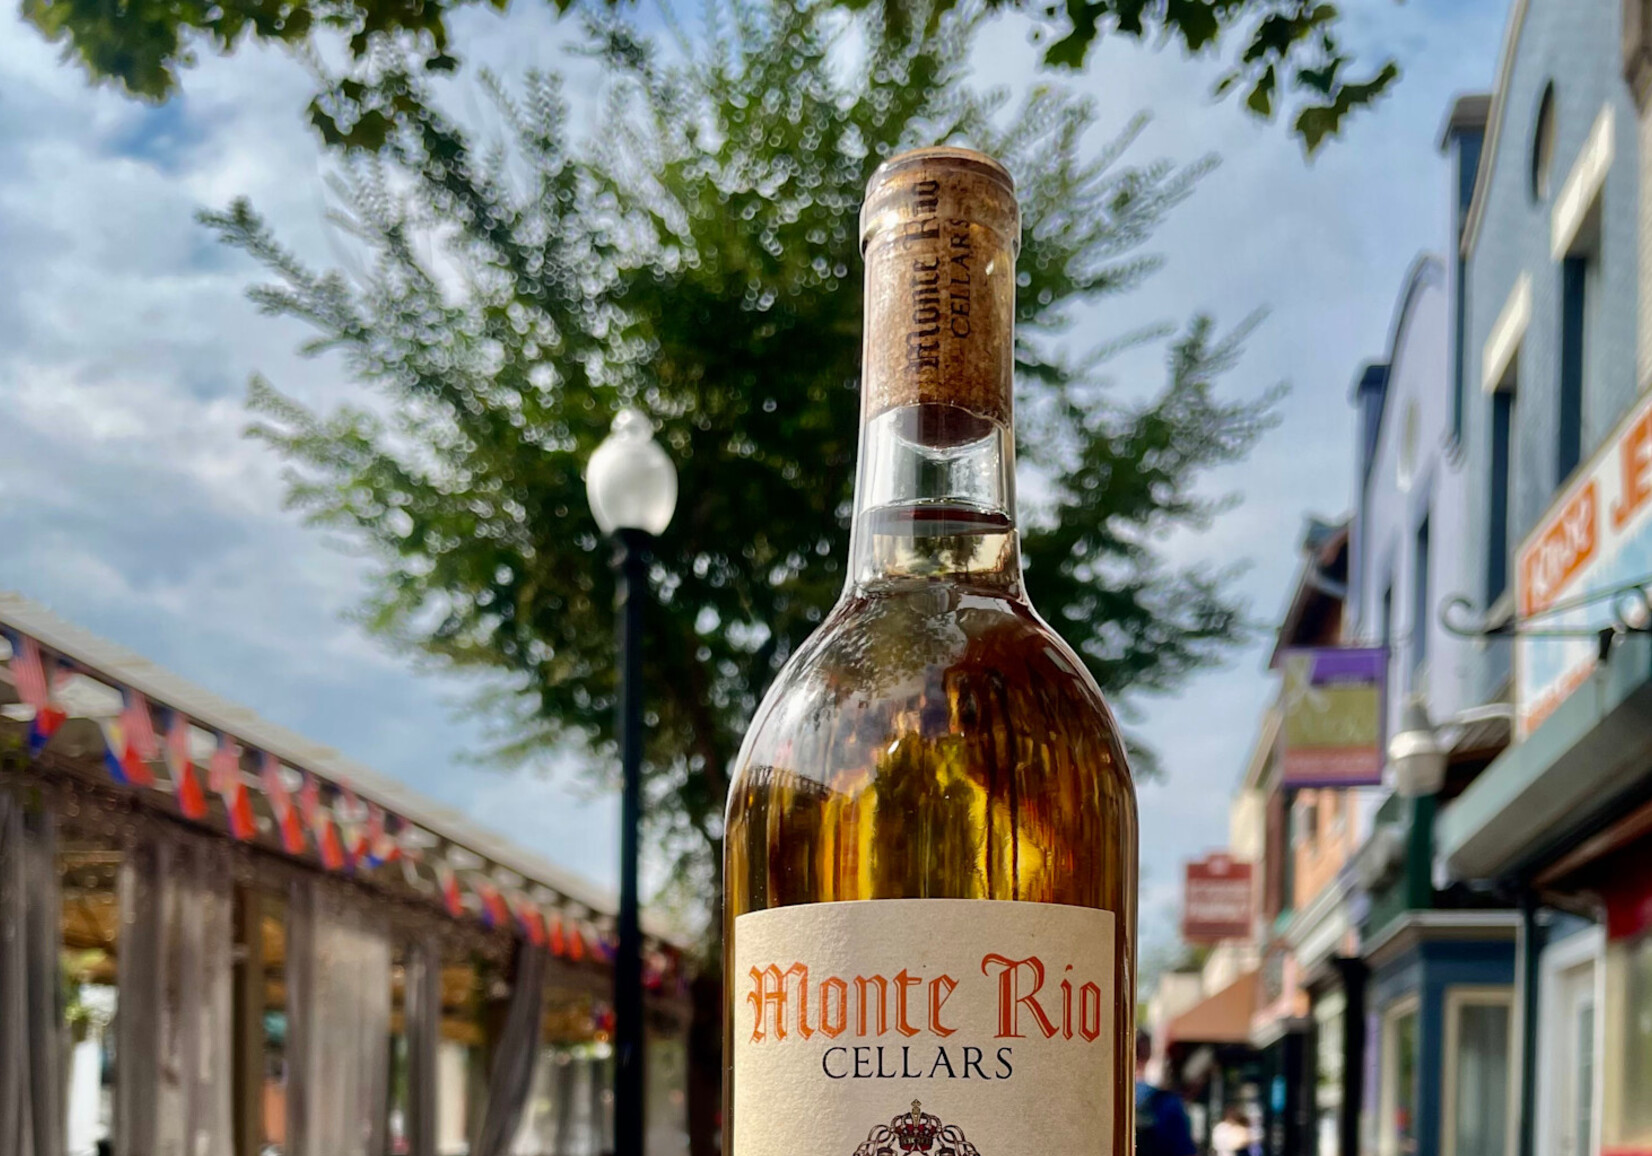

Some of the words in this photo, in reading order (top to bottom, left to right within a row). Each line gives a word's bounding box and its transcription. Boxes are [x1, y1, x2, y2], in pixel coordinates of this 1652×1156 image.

[950, 217, 971, 340] CELLARS
[746, 961, 960, 1045] Monte
[980, 952, 1102, 1043] Rio
[821, 1045, 1013, 1081] CELLARS
